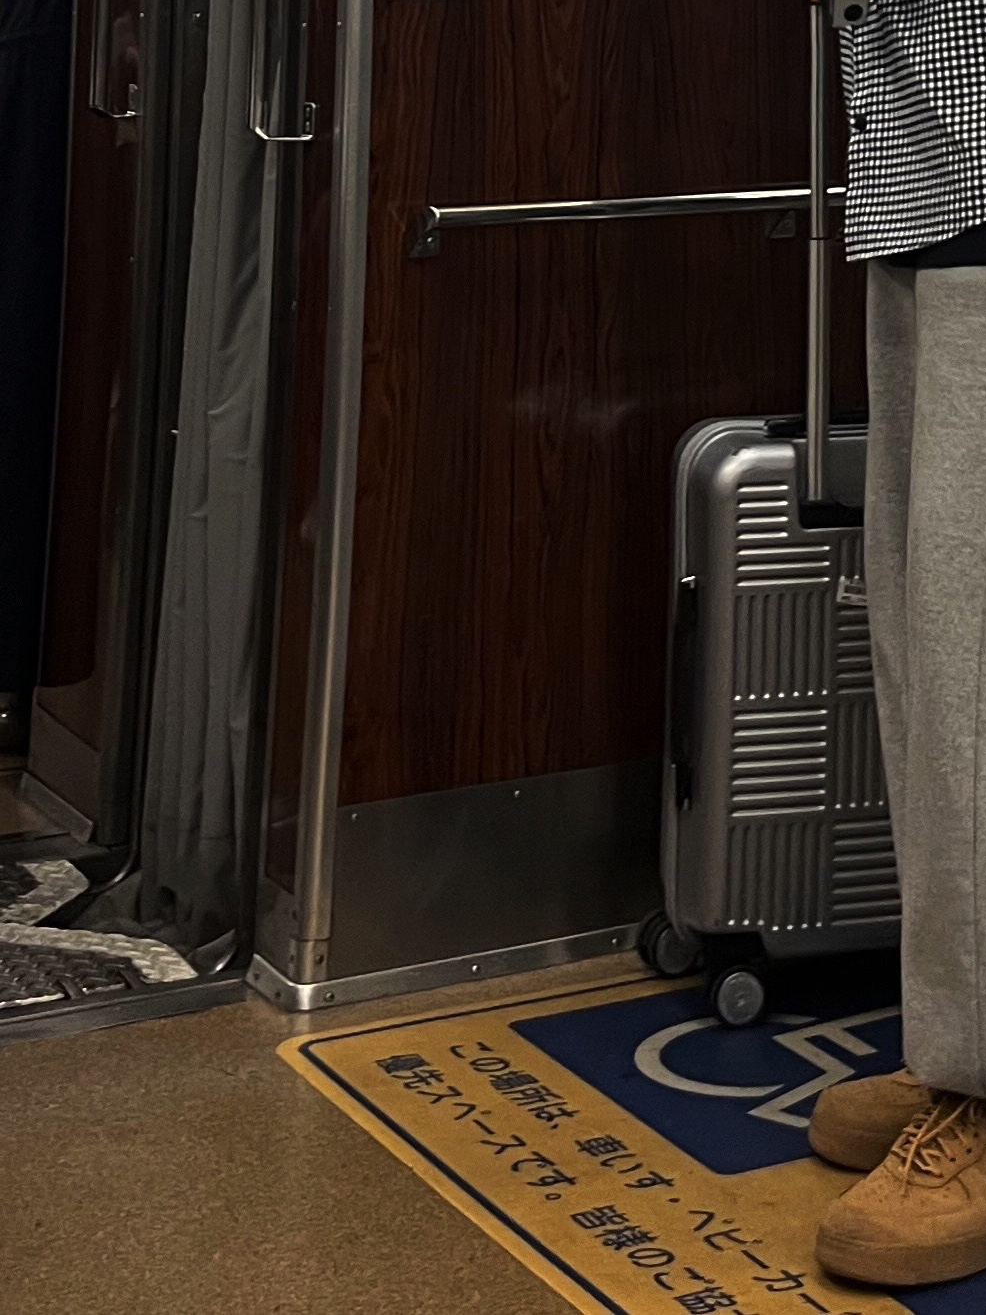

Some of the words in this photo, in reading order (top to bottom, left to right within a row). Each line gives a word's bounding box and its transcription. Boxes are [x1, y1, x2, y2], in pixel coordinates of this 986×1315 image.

[450, 1041, 864, 1315] この場所は、車いす・ベビーカー
